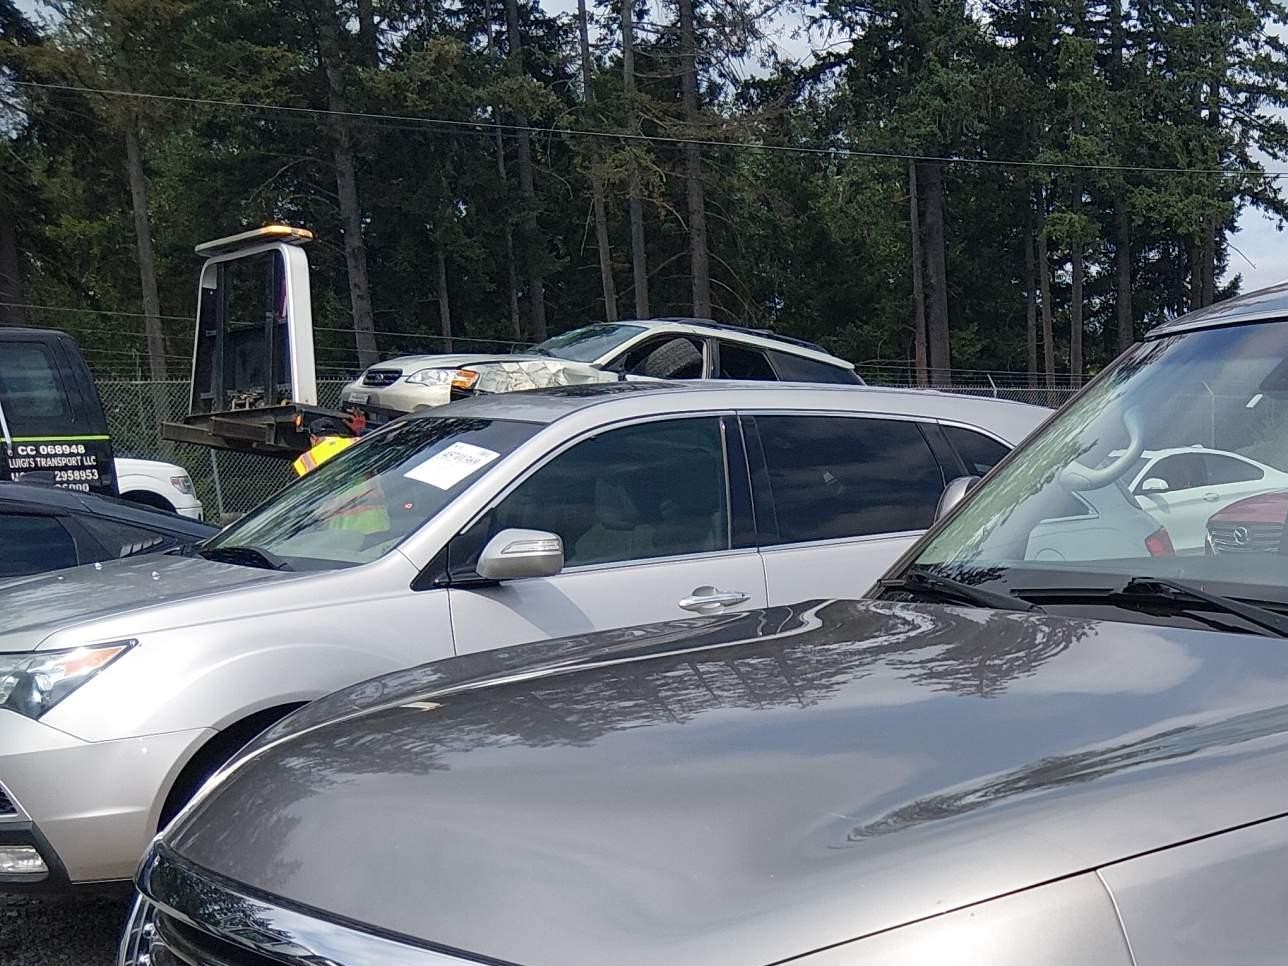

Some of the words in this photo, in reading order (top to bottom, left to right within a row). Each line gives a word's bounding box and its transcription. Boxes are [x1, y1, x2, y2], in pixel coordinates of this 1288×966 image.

[18, 446, 37, 455] CC
[40, 444, 86, 455] 068948
[9, 459, 35, 468] LUIGI'S
[36, 457, 82, 467] TRANSPORT
[83, 456, 97, 466] LLC
[54, 469, 99, 482] 2958953
